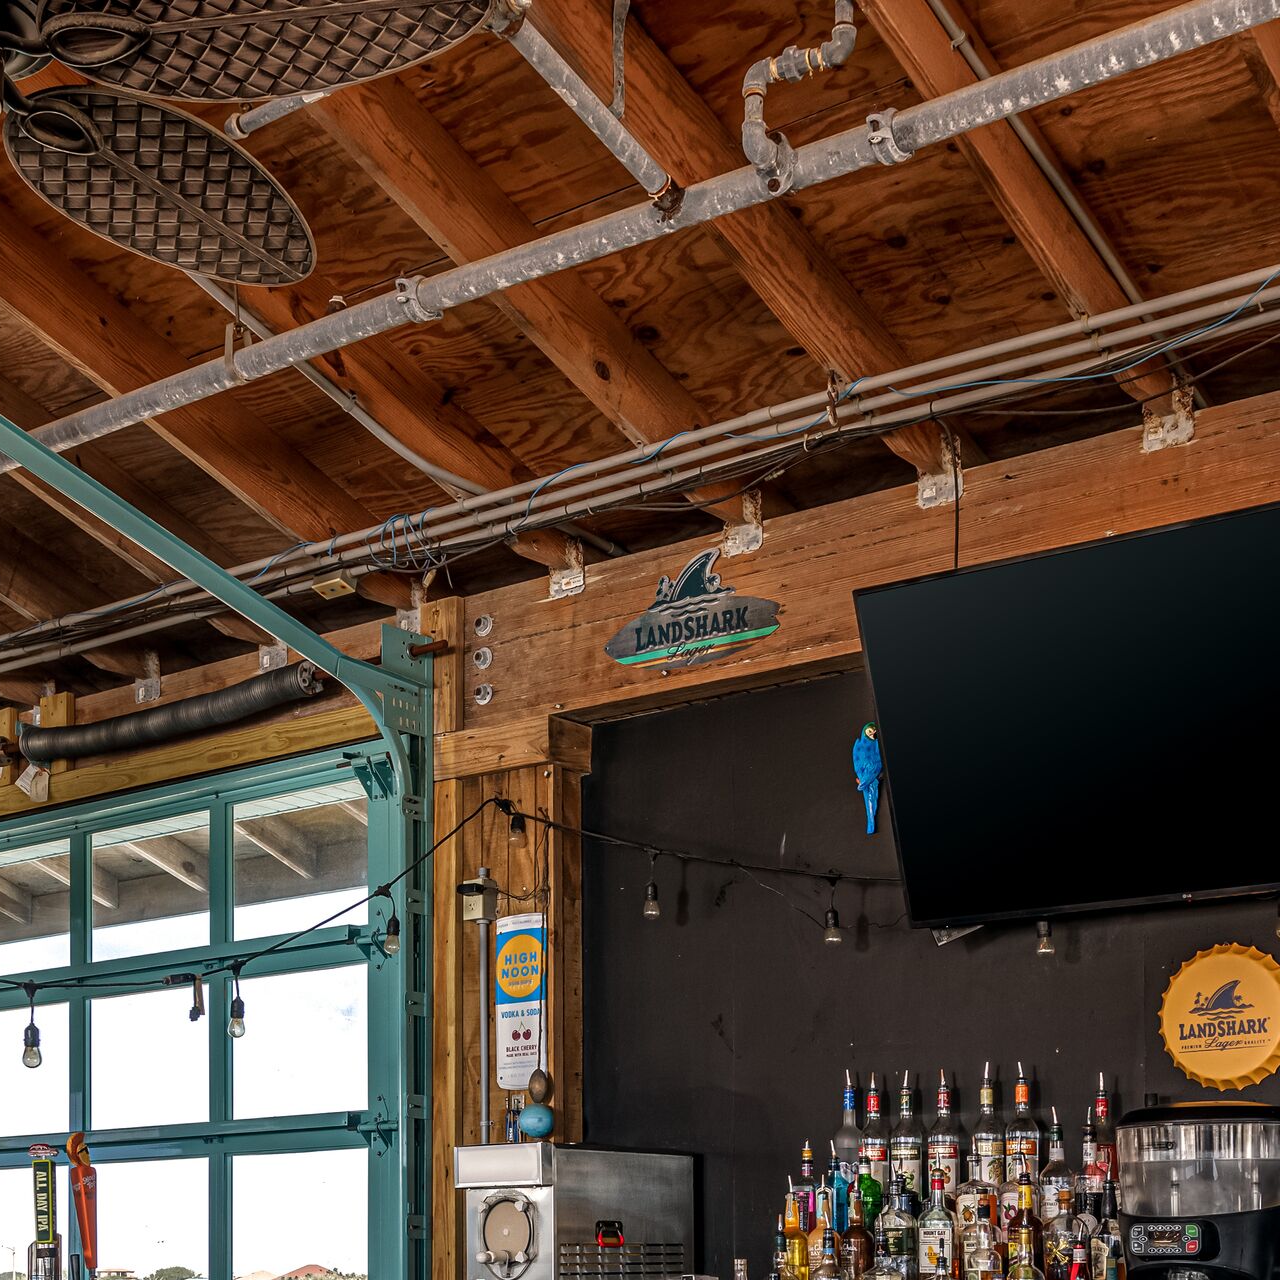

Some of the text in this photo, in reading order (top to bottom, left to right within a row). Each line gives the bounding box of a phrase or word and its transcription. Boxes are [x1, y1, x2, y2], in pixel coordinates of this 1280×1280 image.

[635, 605, 749, 654] LANDSHARK
[667, 642, 715, 666] Lager
[504, 951, 538, 966] HIGH
[501, 965, 540, 979] NOON
[501, 1010, 519, 1019] VODKA
[521, 1009, 525, 1017] &
[1179, 1018, 1268, 1041] LANDSHARK
[1204, 1036, 1244, 1050] Lager
[36, 1171, 49, 1232] ALL DAY IPA
